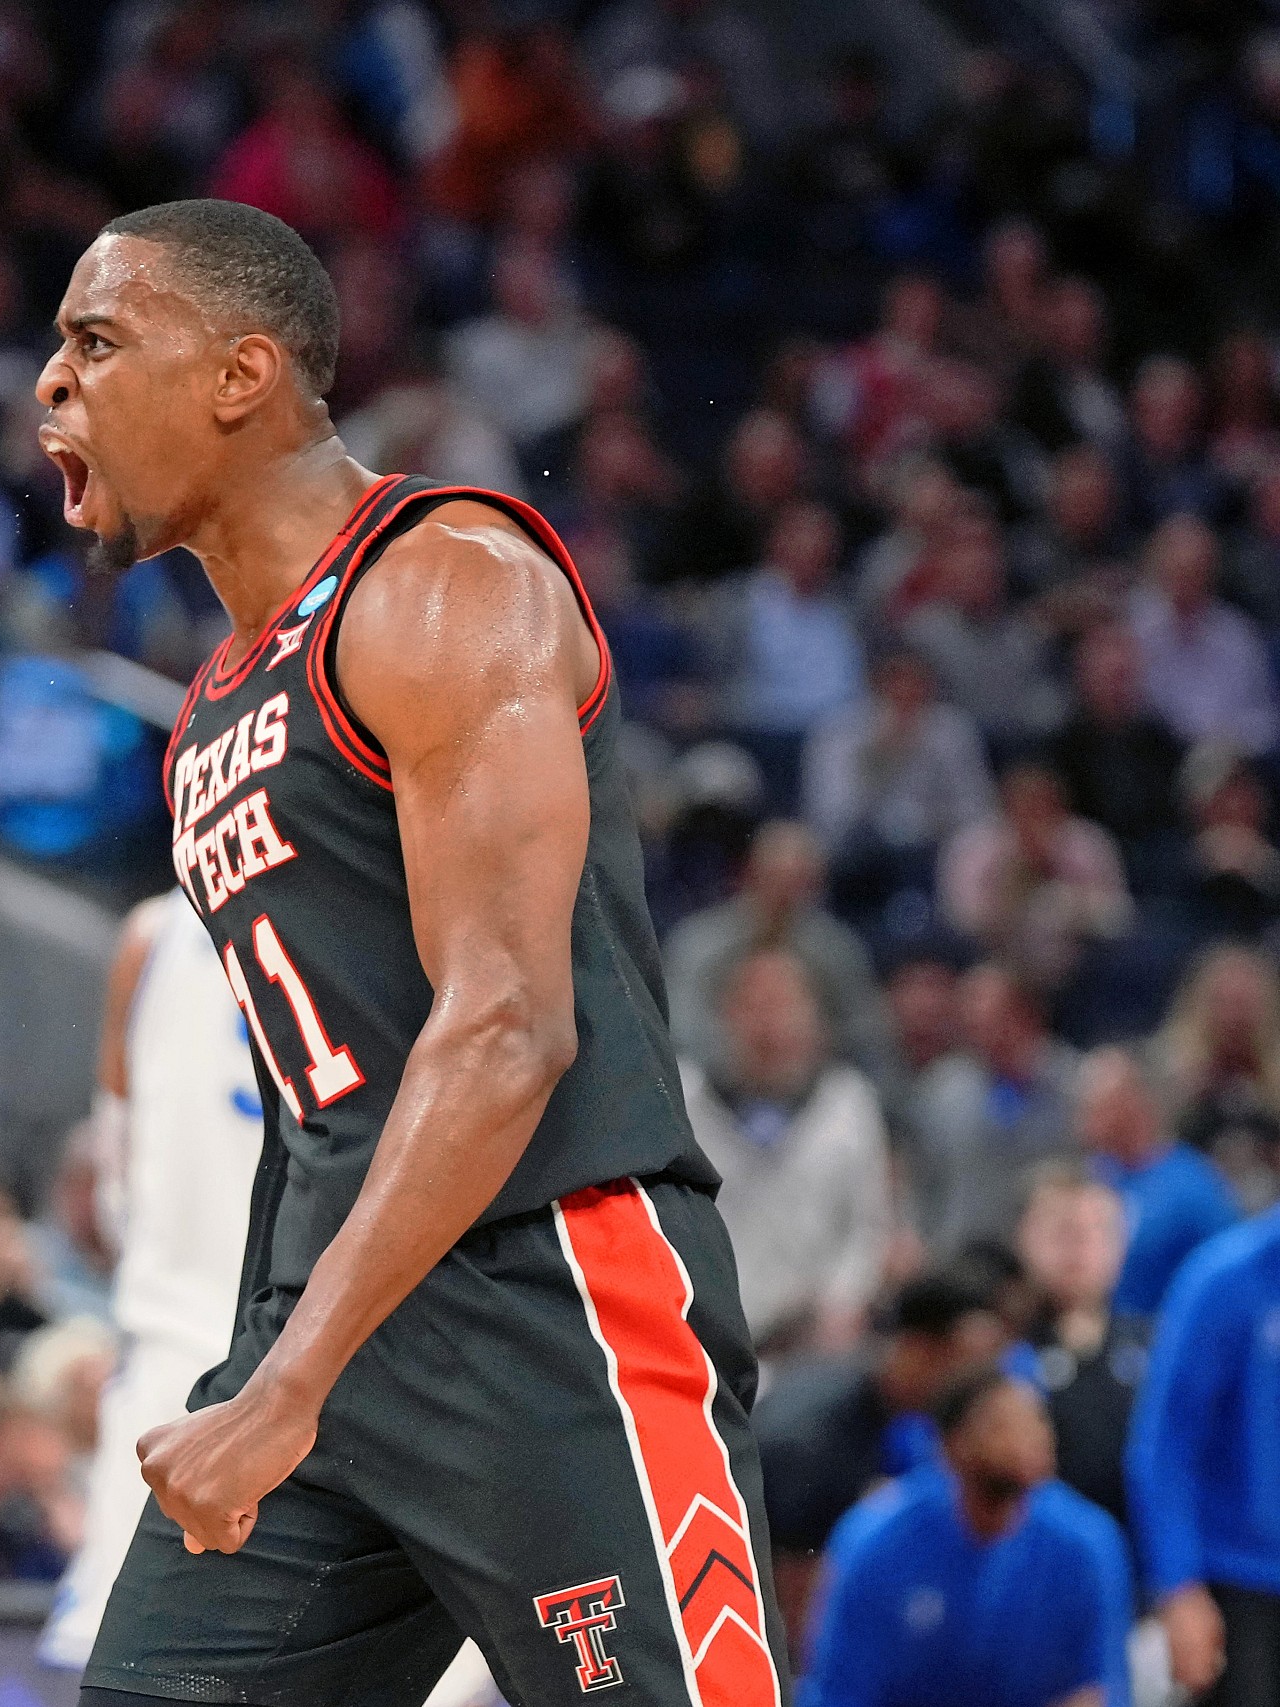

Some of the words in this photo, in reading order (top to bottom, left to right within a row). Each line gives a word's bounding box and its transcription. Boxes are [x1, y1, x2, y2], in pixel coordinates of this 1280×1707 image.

[173, 691, 289, 844] TEXAS
[173, 787, 298, 916] TECH
[223, 913, 366, 1128] 11
